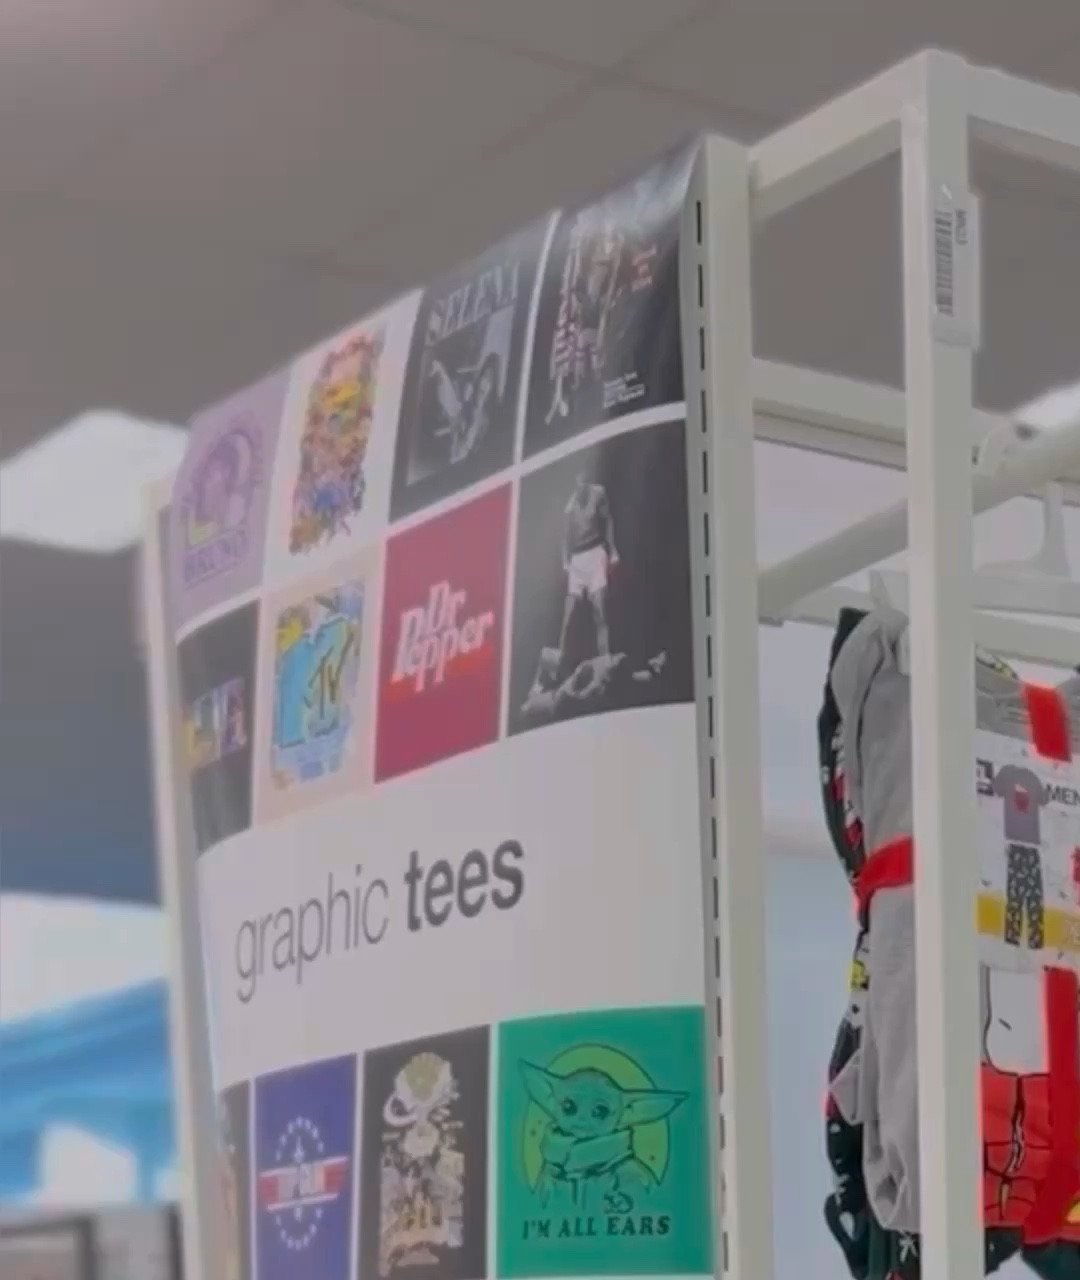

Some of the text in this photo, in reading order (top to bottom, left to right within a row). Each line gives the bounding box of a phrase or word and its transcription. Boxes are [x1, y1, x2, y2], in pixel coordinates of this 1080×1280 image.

[428, 579, 466, 632] Dr
[391, 607, 495, 692] Pepper
[404, 839, 524, 932] tees
[235, 863, 390, 1004] graphic
[522, 1215, 671, 1240] I'M ALL EARS
